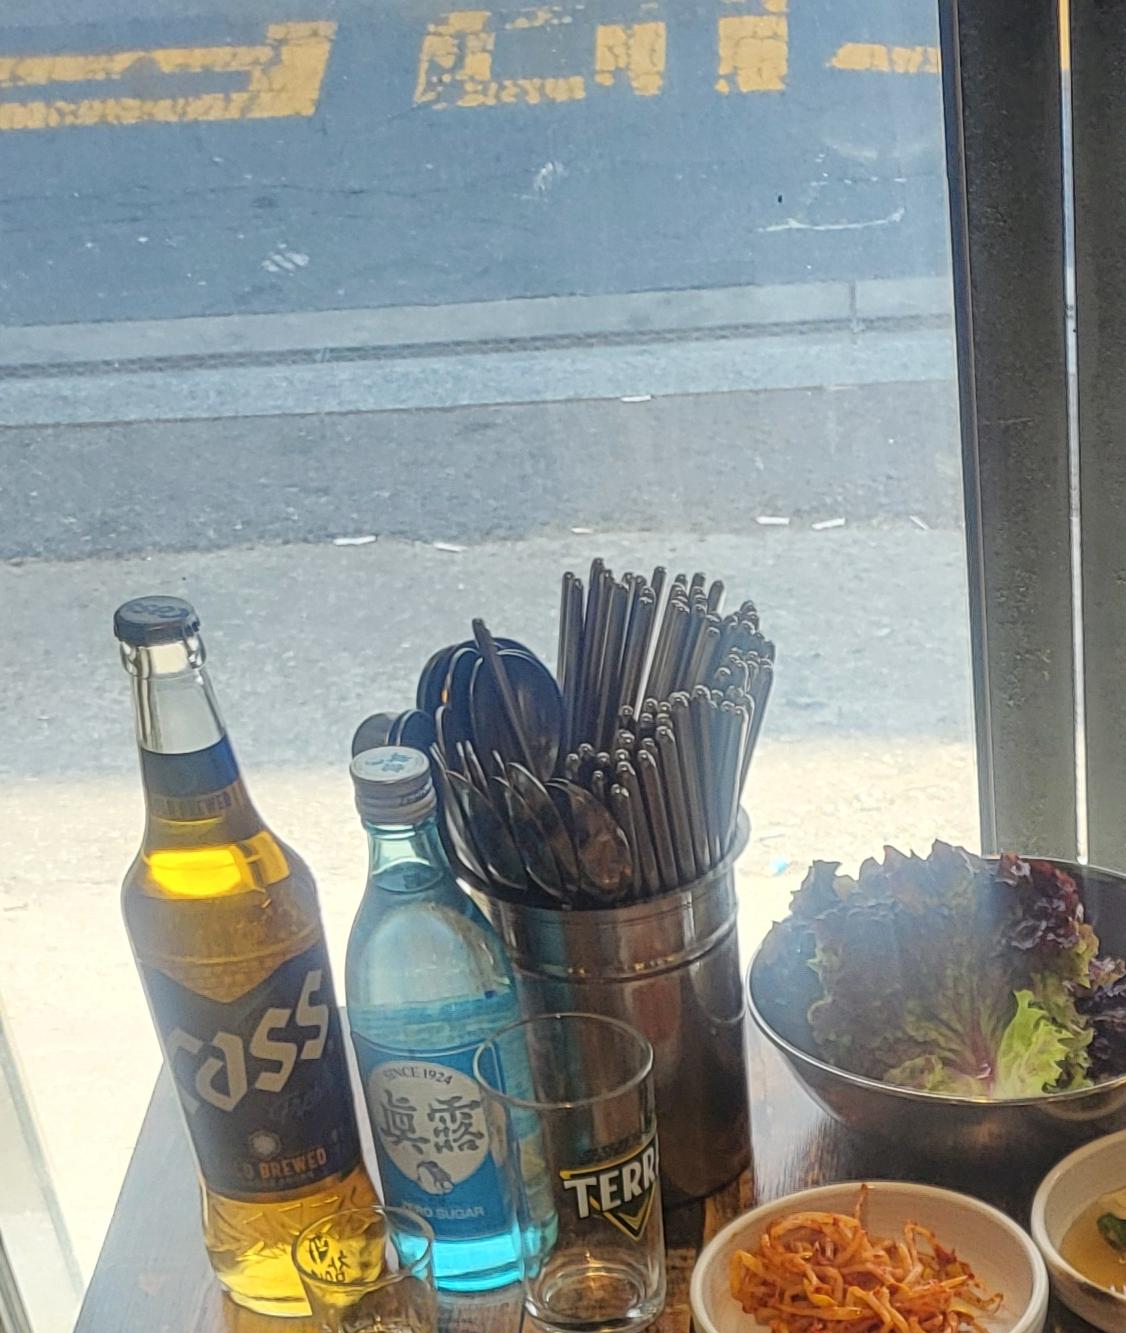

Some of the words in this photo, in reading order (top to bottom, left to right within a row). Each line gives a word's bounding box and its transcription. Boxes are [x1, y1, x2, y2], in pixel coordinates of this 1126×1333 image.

[423, 1068, 453, 1085] 1924
[563, 1135, 659, 1220] TERR
[434, 1205, 485, 1220] SUGAR
